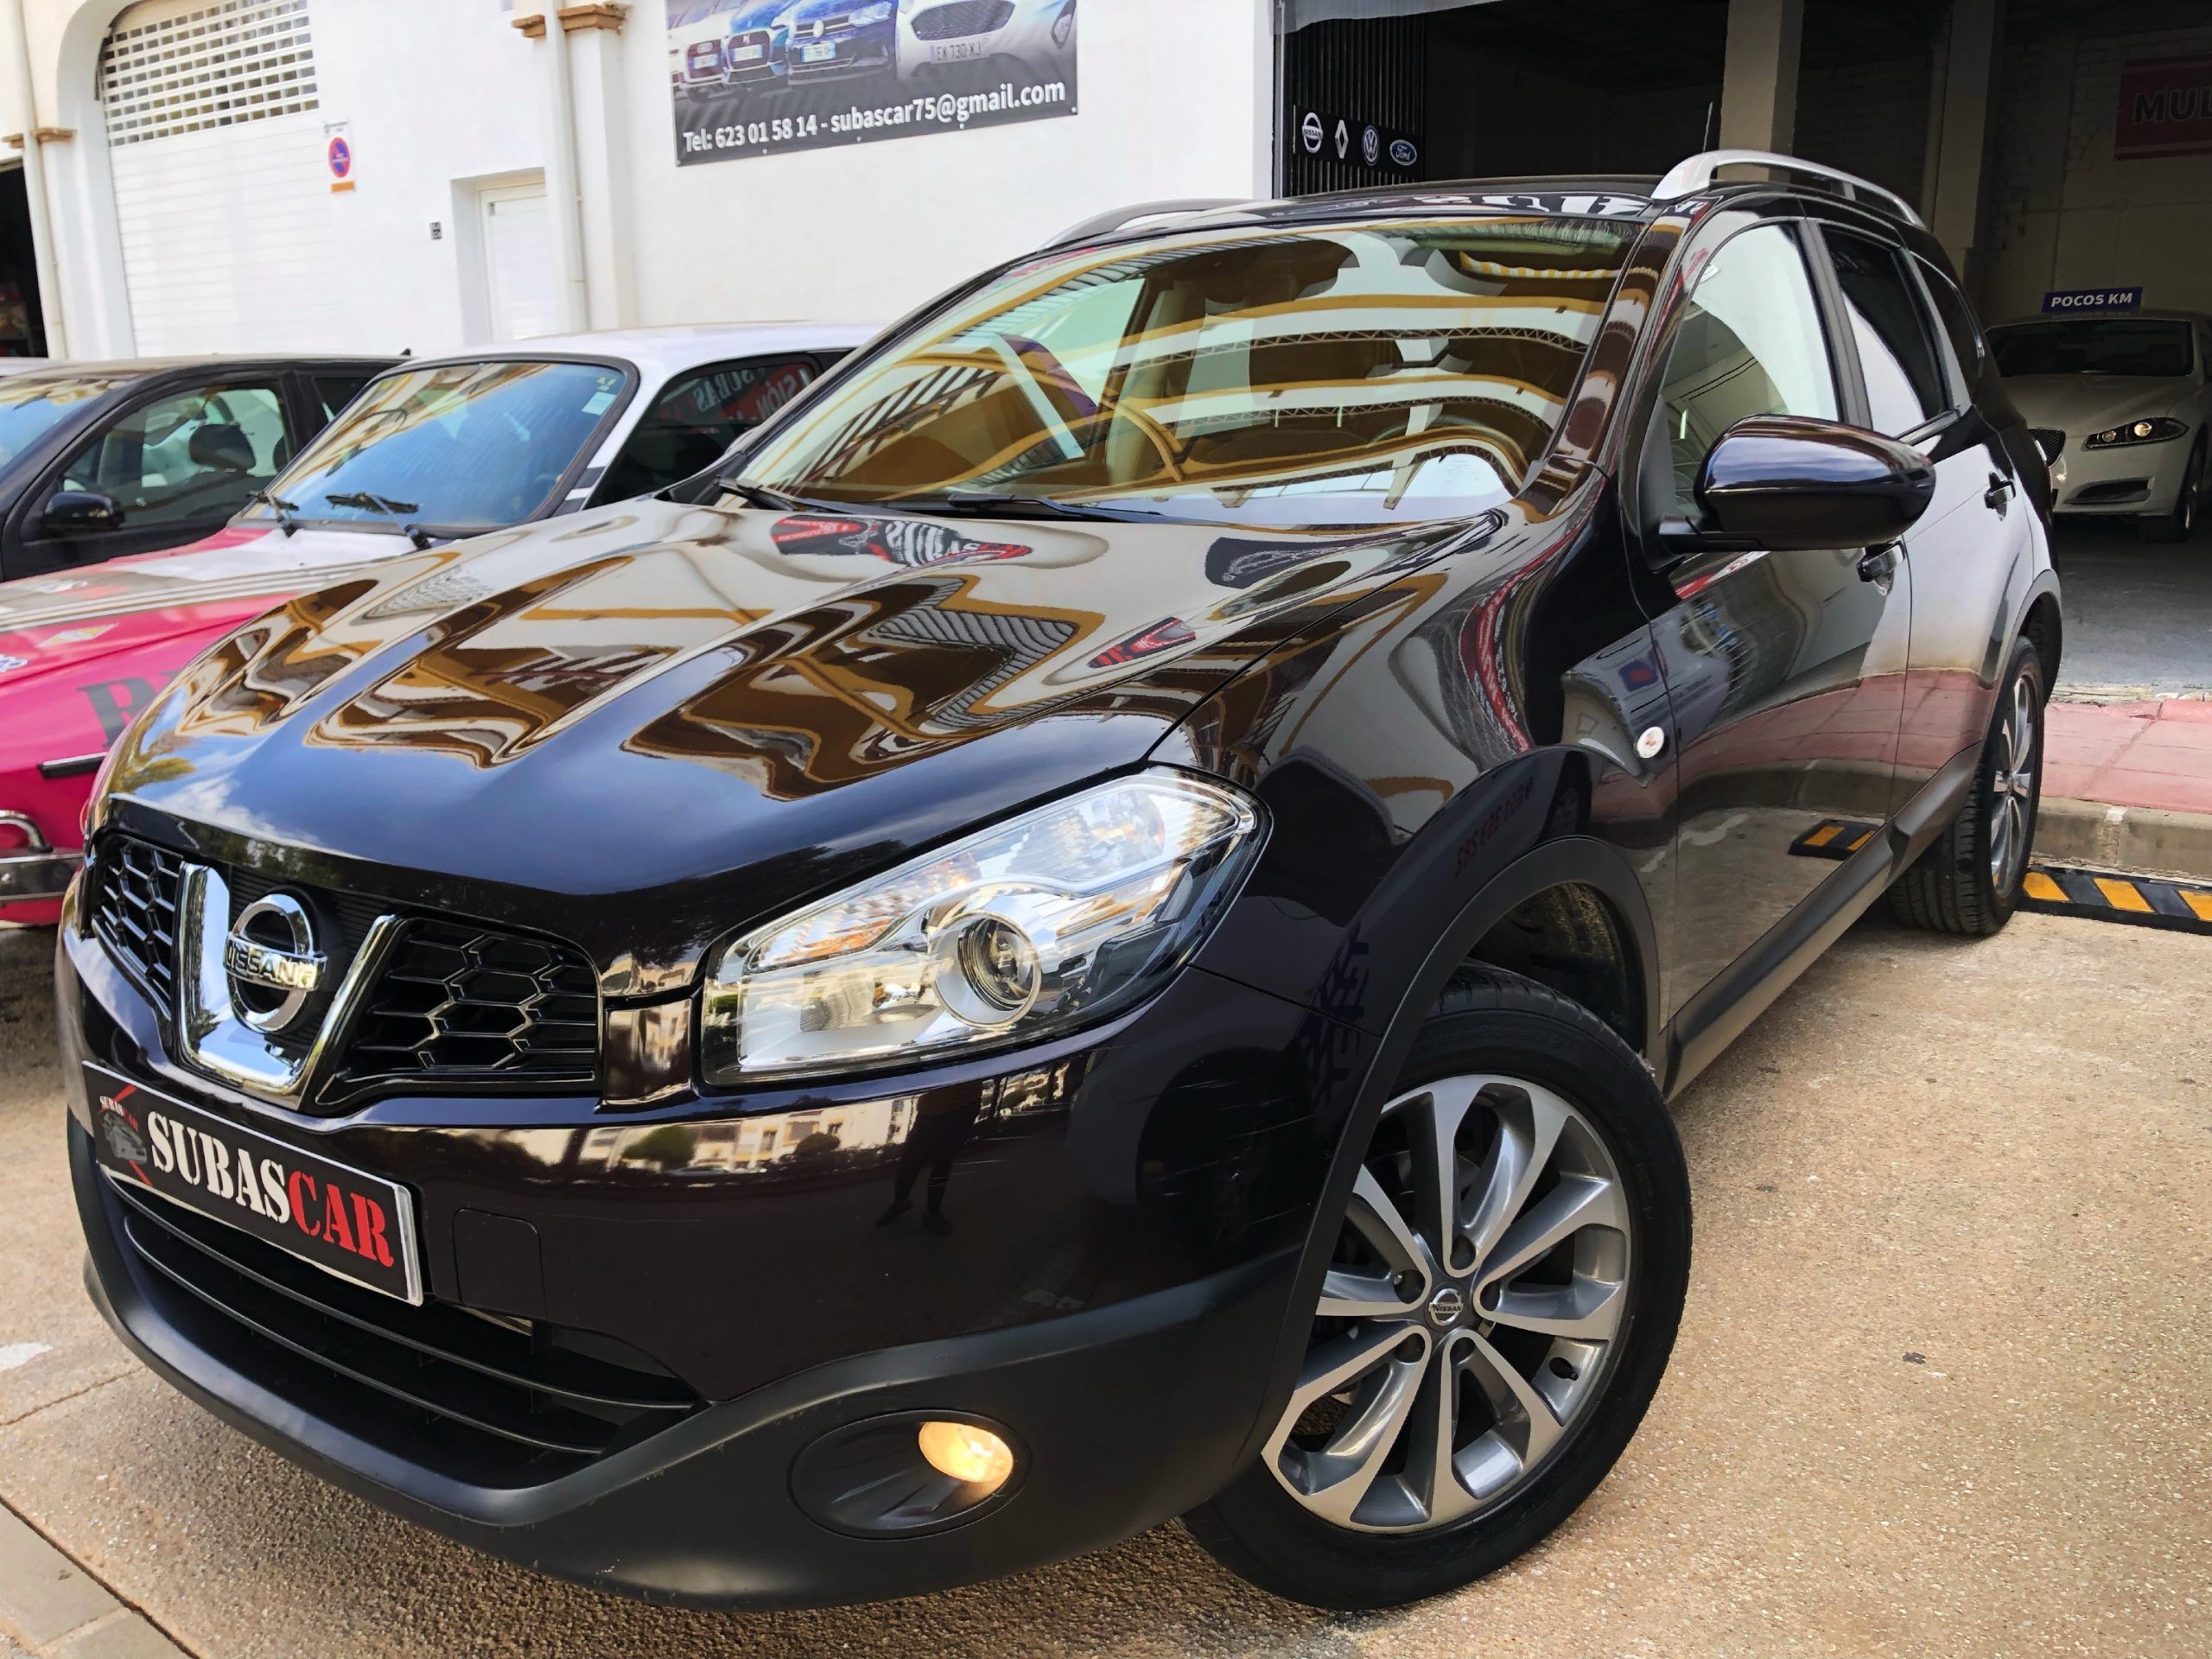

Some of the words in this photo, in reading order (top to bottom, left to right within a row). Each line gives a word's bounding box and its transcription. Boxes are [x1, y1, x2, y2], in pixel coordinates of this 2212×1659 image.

[682, 128, 713, 152] Tel:
[715, 124, 746, 149] 623
[747, 121, 769, 144] 01
[771, 117, 793, 141] 58
[796, 114, 818, 137] 14
[830, 81, 1065, 133] subascar75@gmail.com
[1395, 144, 1412, 161] Ford
[2050, 294, 2105, 308] POCOS
[2107, 292, 2133, 305] KM
[147, 1110, 395, 1268] SUBASCAR
